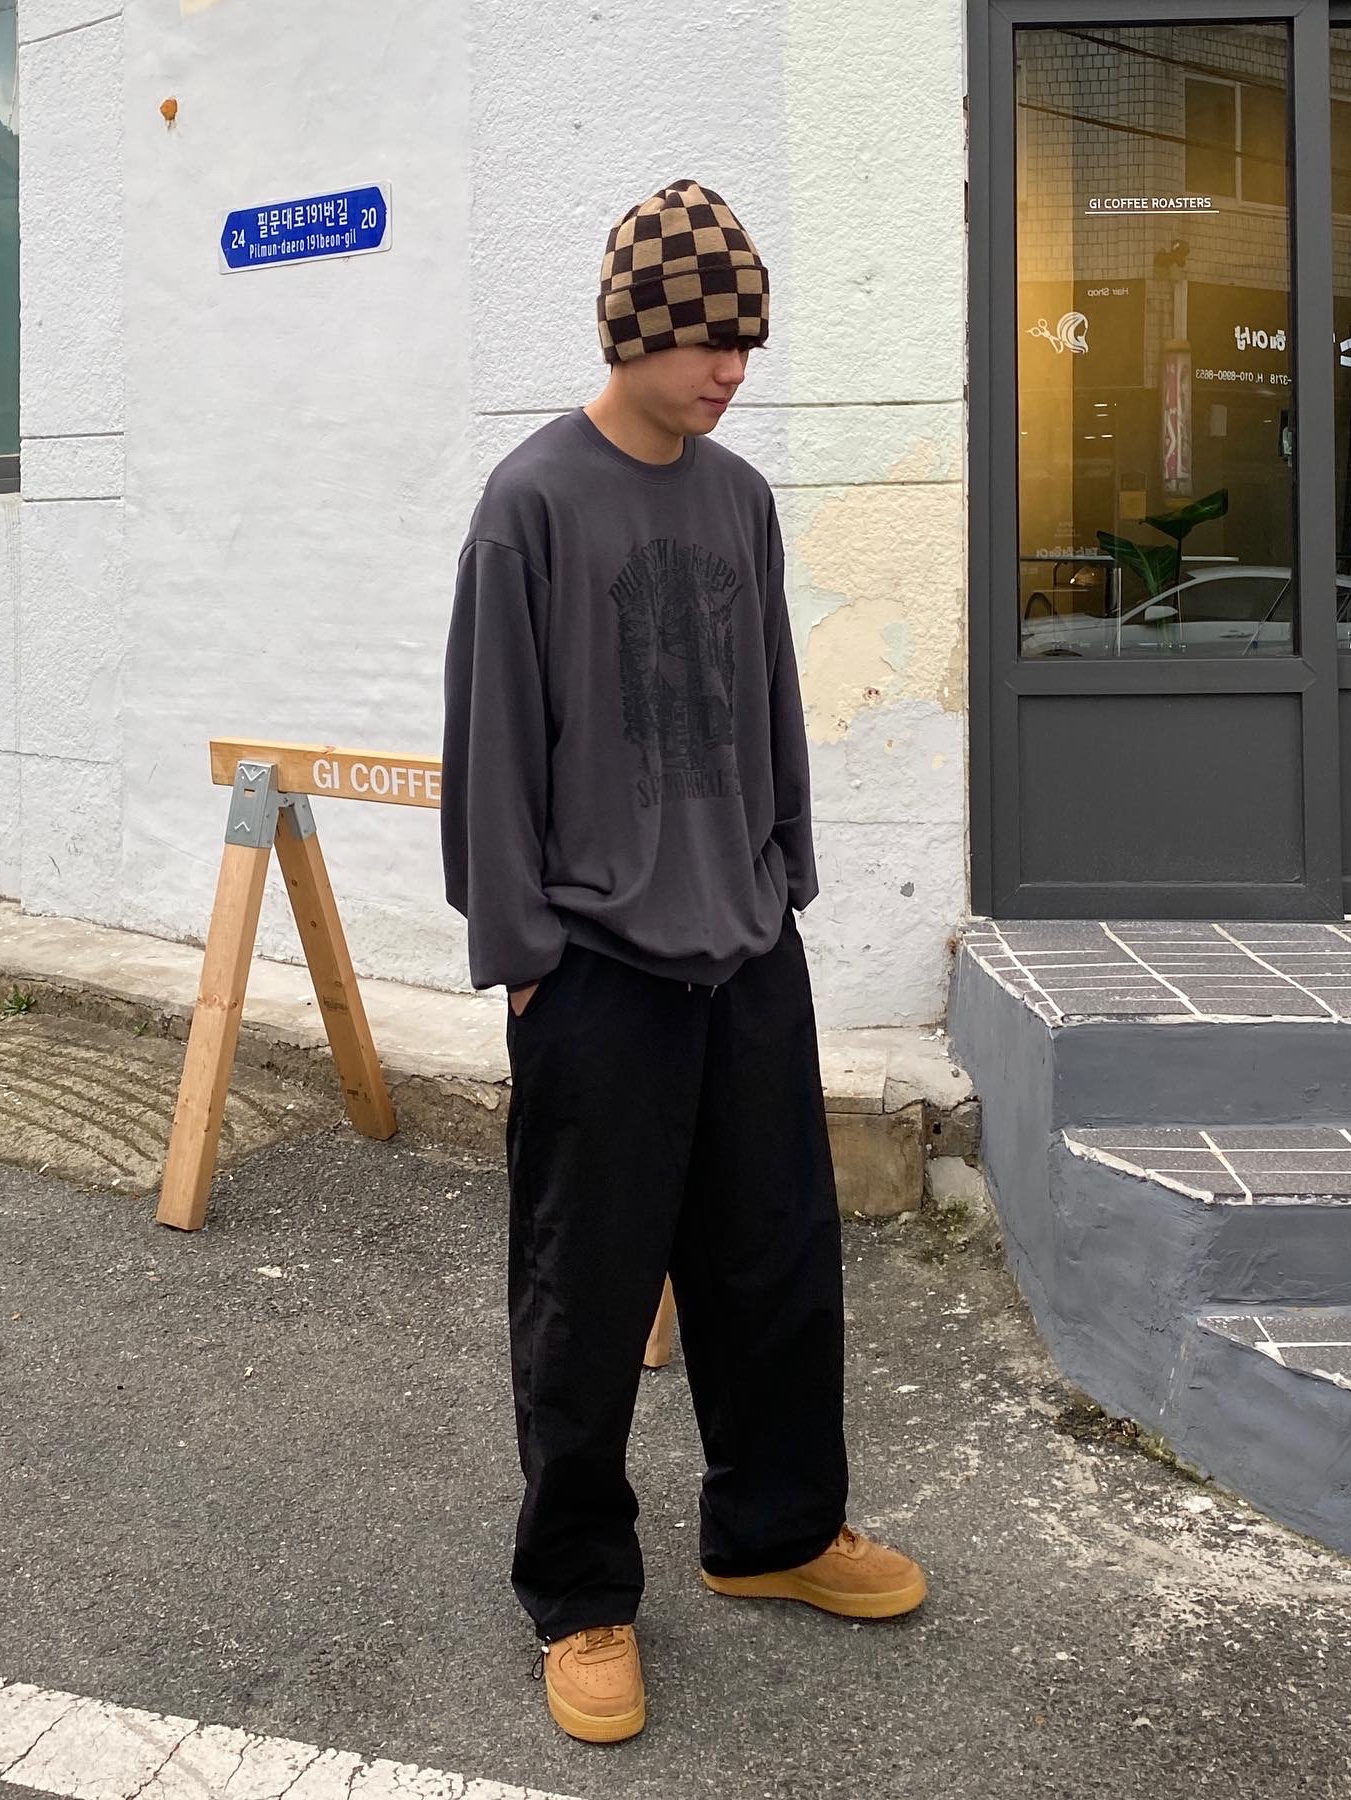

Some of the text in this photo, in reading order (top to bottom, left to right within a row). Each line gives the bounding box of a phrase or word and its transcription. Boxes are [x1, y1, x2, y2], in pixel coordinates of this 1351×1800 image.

[1088, 197, 1212, 209] GI COFFEE ROASTERS
[257, 198, 348, 239] 필문대로191번길
[361, 207, 377, 230] 20
[231, 229, 246, 249] 24
[249, 228, 357, 259] Pilmun-daero 191beon-gil
[312, 758, 341, 790] GI
